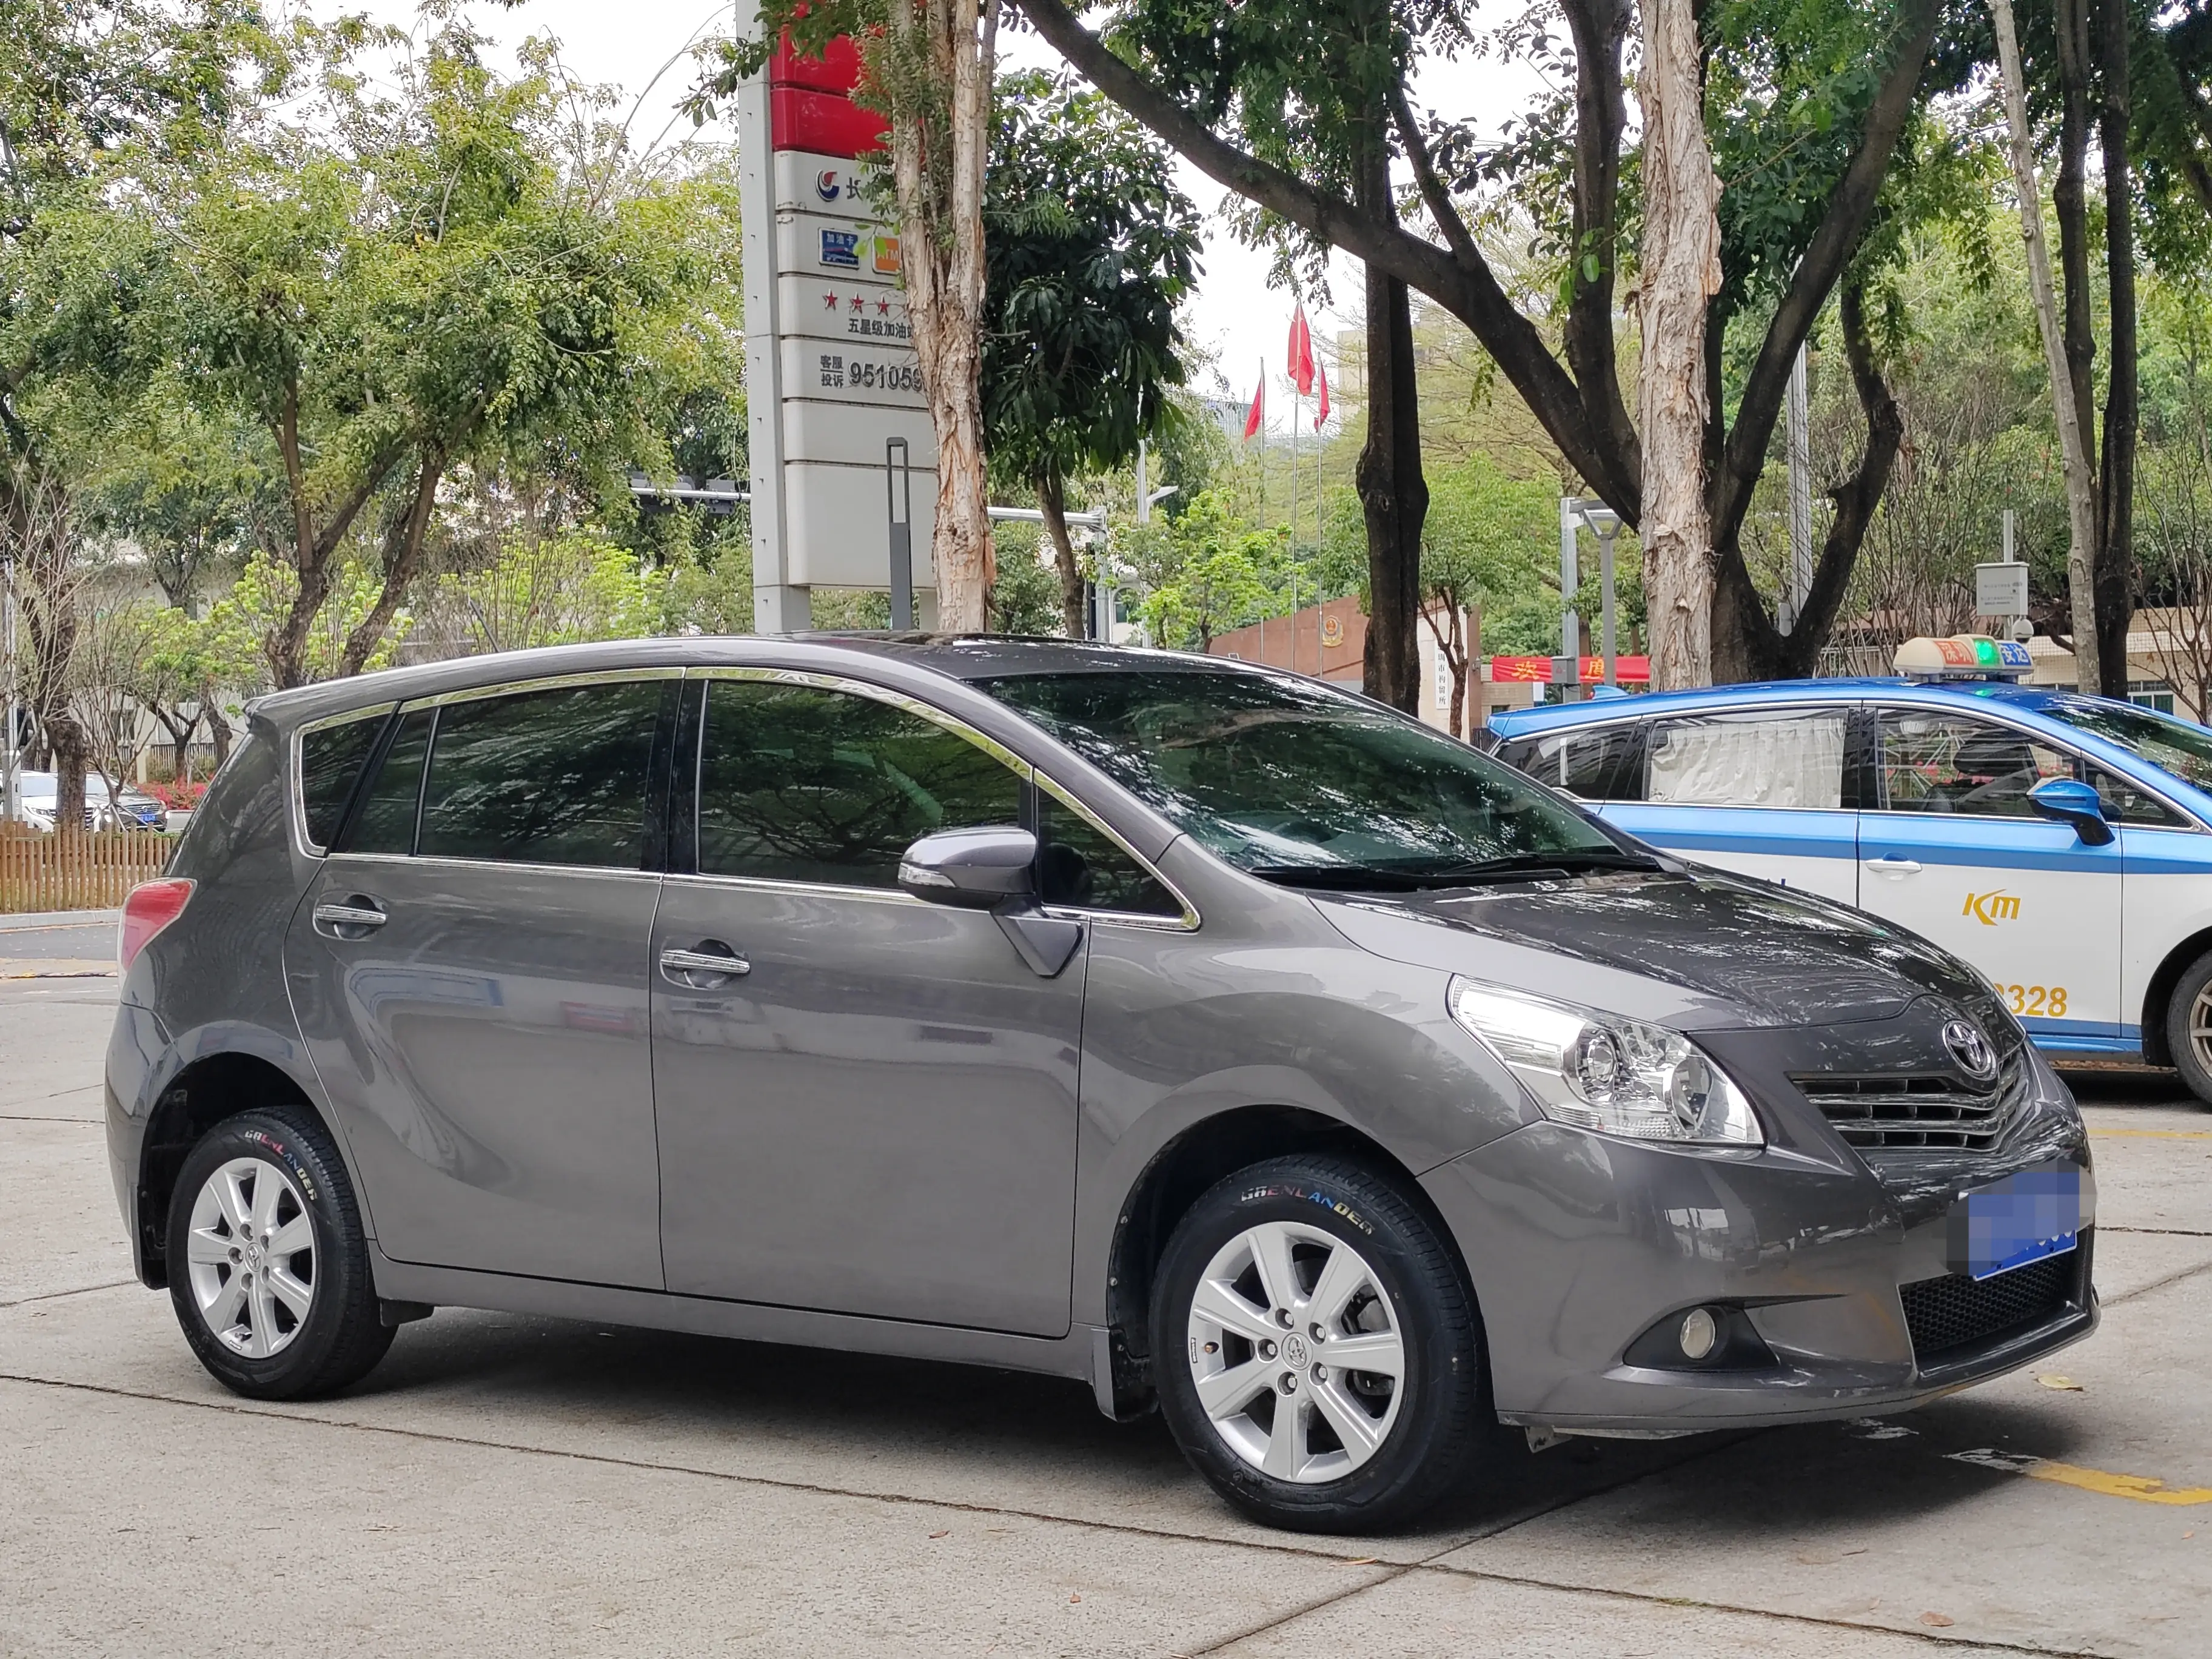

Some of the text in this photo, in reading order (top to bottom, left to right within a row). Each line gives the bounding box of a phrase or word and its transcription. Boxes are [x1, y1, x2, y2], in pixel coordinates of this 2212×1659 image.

[820, 354, 843, 369] 客服
[821, 373, 844, 389] 投诉
[1937, 641, 2029, 664] 深圳 安达
[1438, 645, 1447, 705] 圳市拘留所
[1994, 982, 2068, 1017] 328
